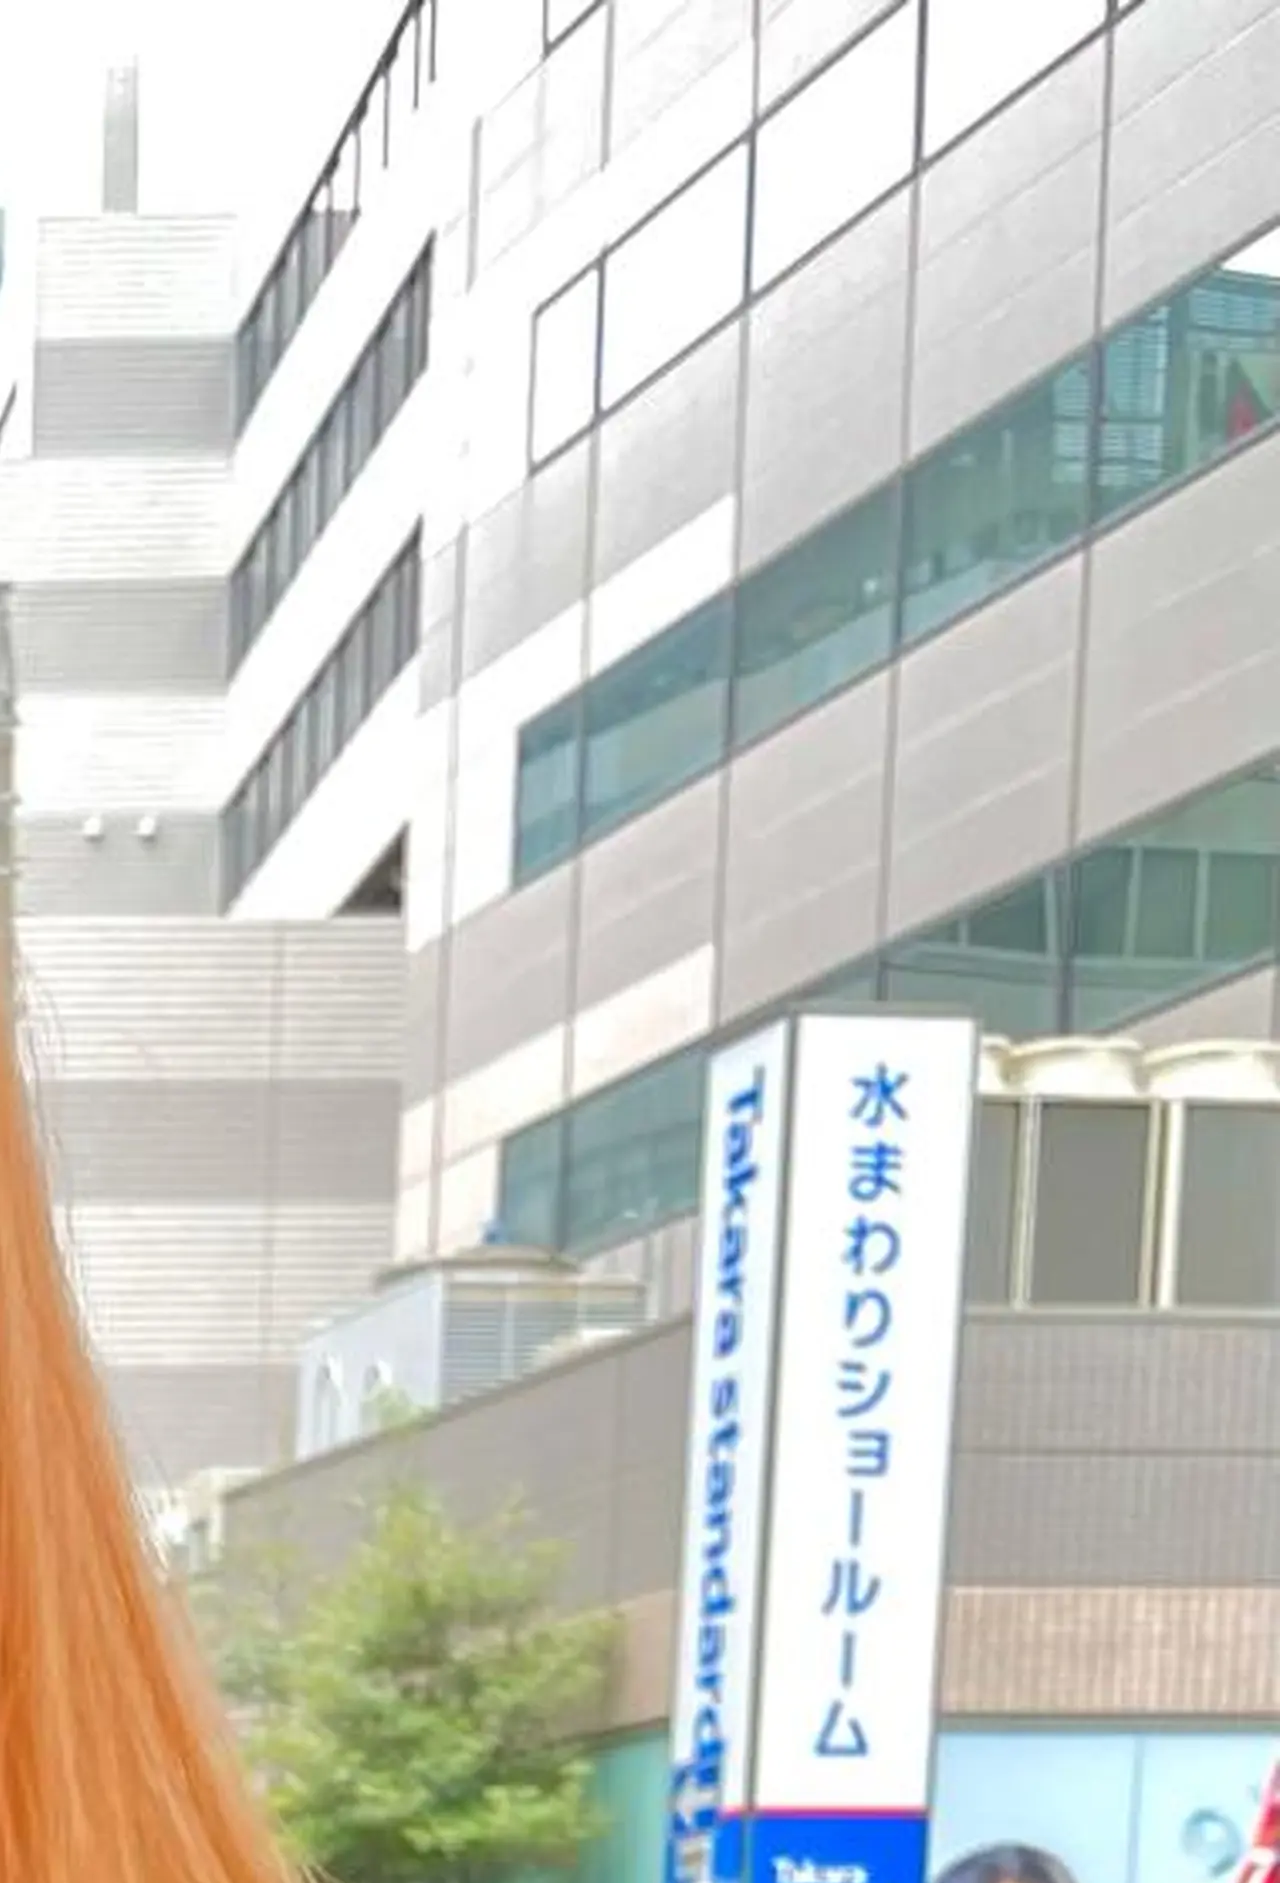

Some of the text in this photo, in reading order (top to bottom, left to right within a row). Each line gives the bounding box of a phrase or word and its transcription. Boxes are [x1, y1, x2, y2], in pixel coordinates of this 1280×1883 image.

[693, 1065, 766, 1760] Takara standard
[814, 1063, 910, 1757] 水まわりショールーム
